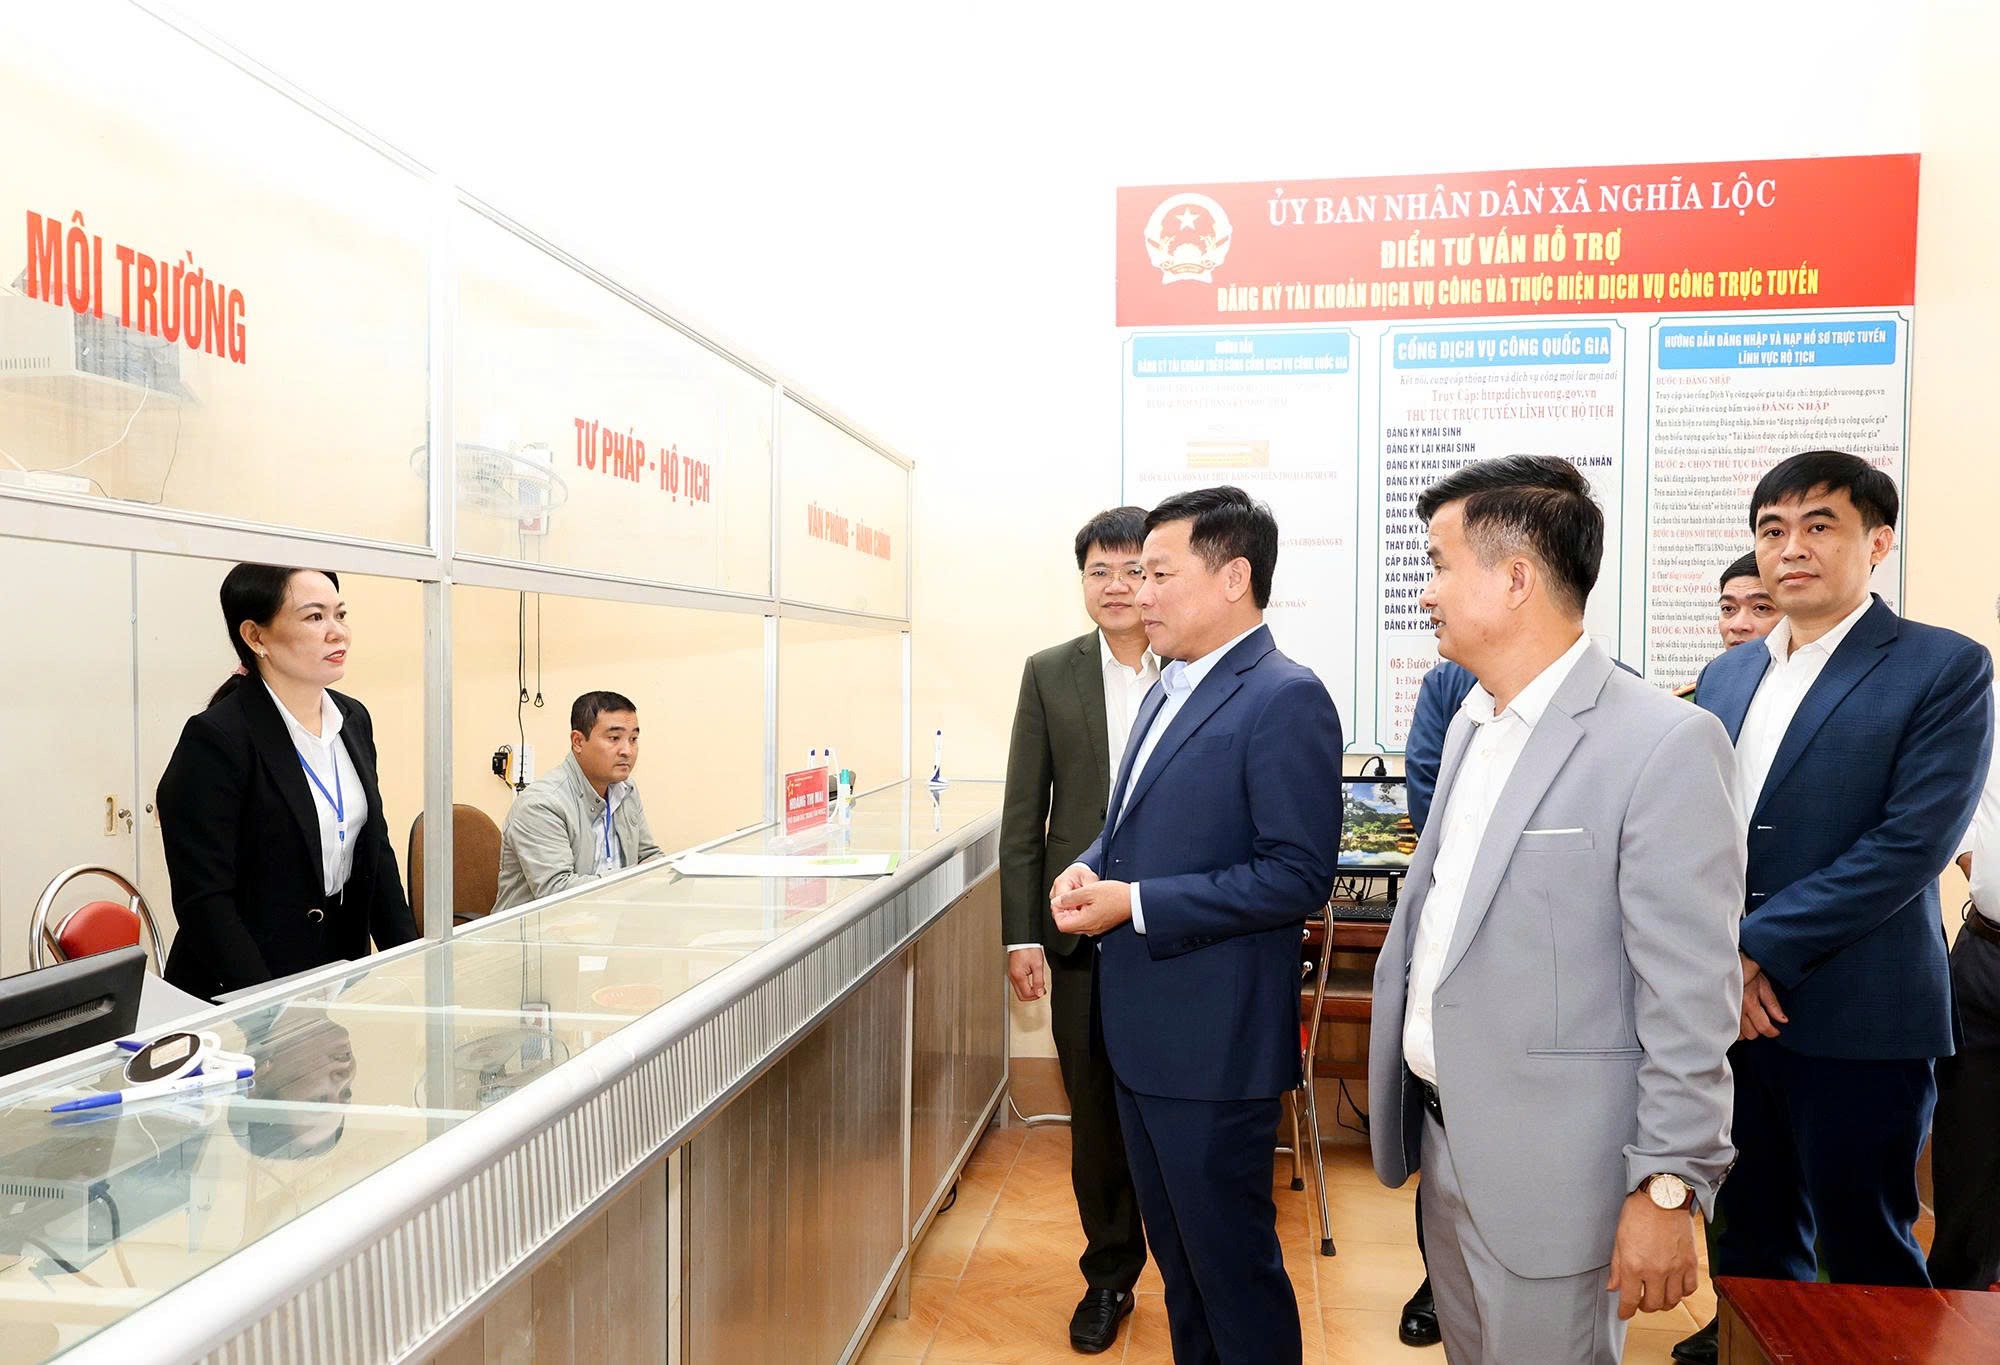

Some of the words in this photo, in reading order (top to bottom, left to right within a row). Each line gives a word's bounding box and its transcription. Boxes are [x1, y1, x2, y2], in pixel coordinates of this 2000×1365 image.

[1267, 187, 1310, 226] ỦY
[1314, 195, 1376, 224] BAN
[1384, 184, 1472, 222] NHÂN
[1479, 180, 1544, 218] DÂN
[1549, 177, 1592, 213] XÃ
[1597, 176, 1703, 212] NGHĨA
[1711, 172, 1776, 216] LỘC
[1442, 232, 1475, 267] TƯ
[1479, 226, 1526, 265] VẤN
[1533, 224, 1566, 262] HỖ
[1573, 227, 1622, 266] TRỢ
[26, 210, 104, 319] MÔI
[116, 250, 247, 365] TRƯỜNG
[1217, 281, 1258, 312] ĐĂNG
[1262, 281, 1282, 311] KÝ
[1286, 281, 1310, 310] TÀI
[1314, 277, 1367, 309] KHOẢN
[1371, 280, 1409, 312] DỊCH
[1413, 280, 1435, 310] VỤ
[1438, 275, 1482, 305] CÔNG
[1485, 274, 1507, 304] VÀ
[1510, 272, 1553, 306] THỰC
[1557, 270, 1595, 305] HIỆN
[1599, 272, 1639, 304] DỊCH
[1642, 272, 1665, 303] VỤ
[1669, 267, 1714, 299] CÔNG
[1718, 266, 1763, 301] TRỰC
[1767, 260, 1819, 296] TUYẾN
[1440, 339, 1474, 362] DỊCH
[1477, 339, 1496, 361] VỤ
[1499, 335, 1539, 357] CÔNG
[1541, 331, 1581, 358] QUỐC
[1584, 335, 1609, 355] GIA
[1743, 331, 1768, 348] NHẬP
[1769, 330, 1781, 346] VÀ
[1782, 332, 1802, 347] NẠP
[1818, 330, 1831, 344] SƠ
[1832, 330, 1855, 346] TRỰC
[1857, 327, 1886, 343] TUYẾN
[1738, 350, 1760, 365] LĨNH
[1761, 350, 1779, 366] VỰC
[1780, 348, 1793, 366] HỘ
[1794, 350, 1815, 366] TỊCH
[1422, 427, 1440, 438] KHAI
[1442, 427, 1462, 437] SINH
[1422, 443, 1434, 456] LẠI
[1435, 443, 1454, 453] KHAI
[1457, 443, 1476, 453] SINH
[575, 417, 598, 470] TƯ
[603, 427, 645, 483] PHÁP
[650, 462, 655, 471] -
[660, 443, 679, 503] HỘ
[683, 456, 710, 507] TỊCH
[1422, 459, 1440, 469] KHAI
[1442, 459, 1461, 469] SINH
[1385, 540, 1405, 551] THAY
[1384, 619, 1406, 631] ĐĂNG
